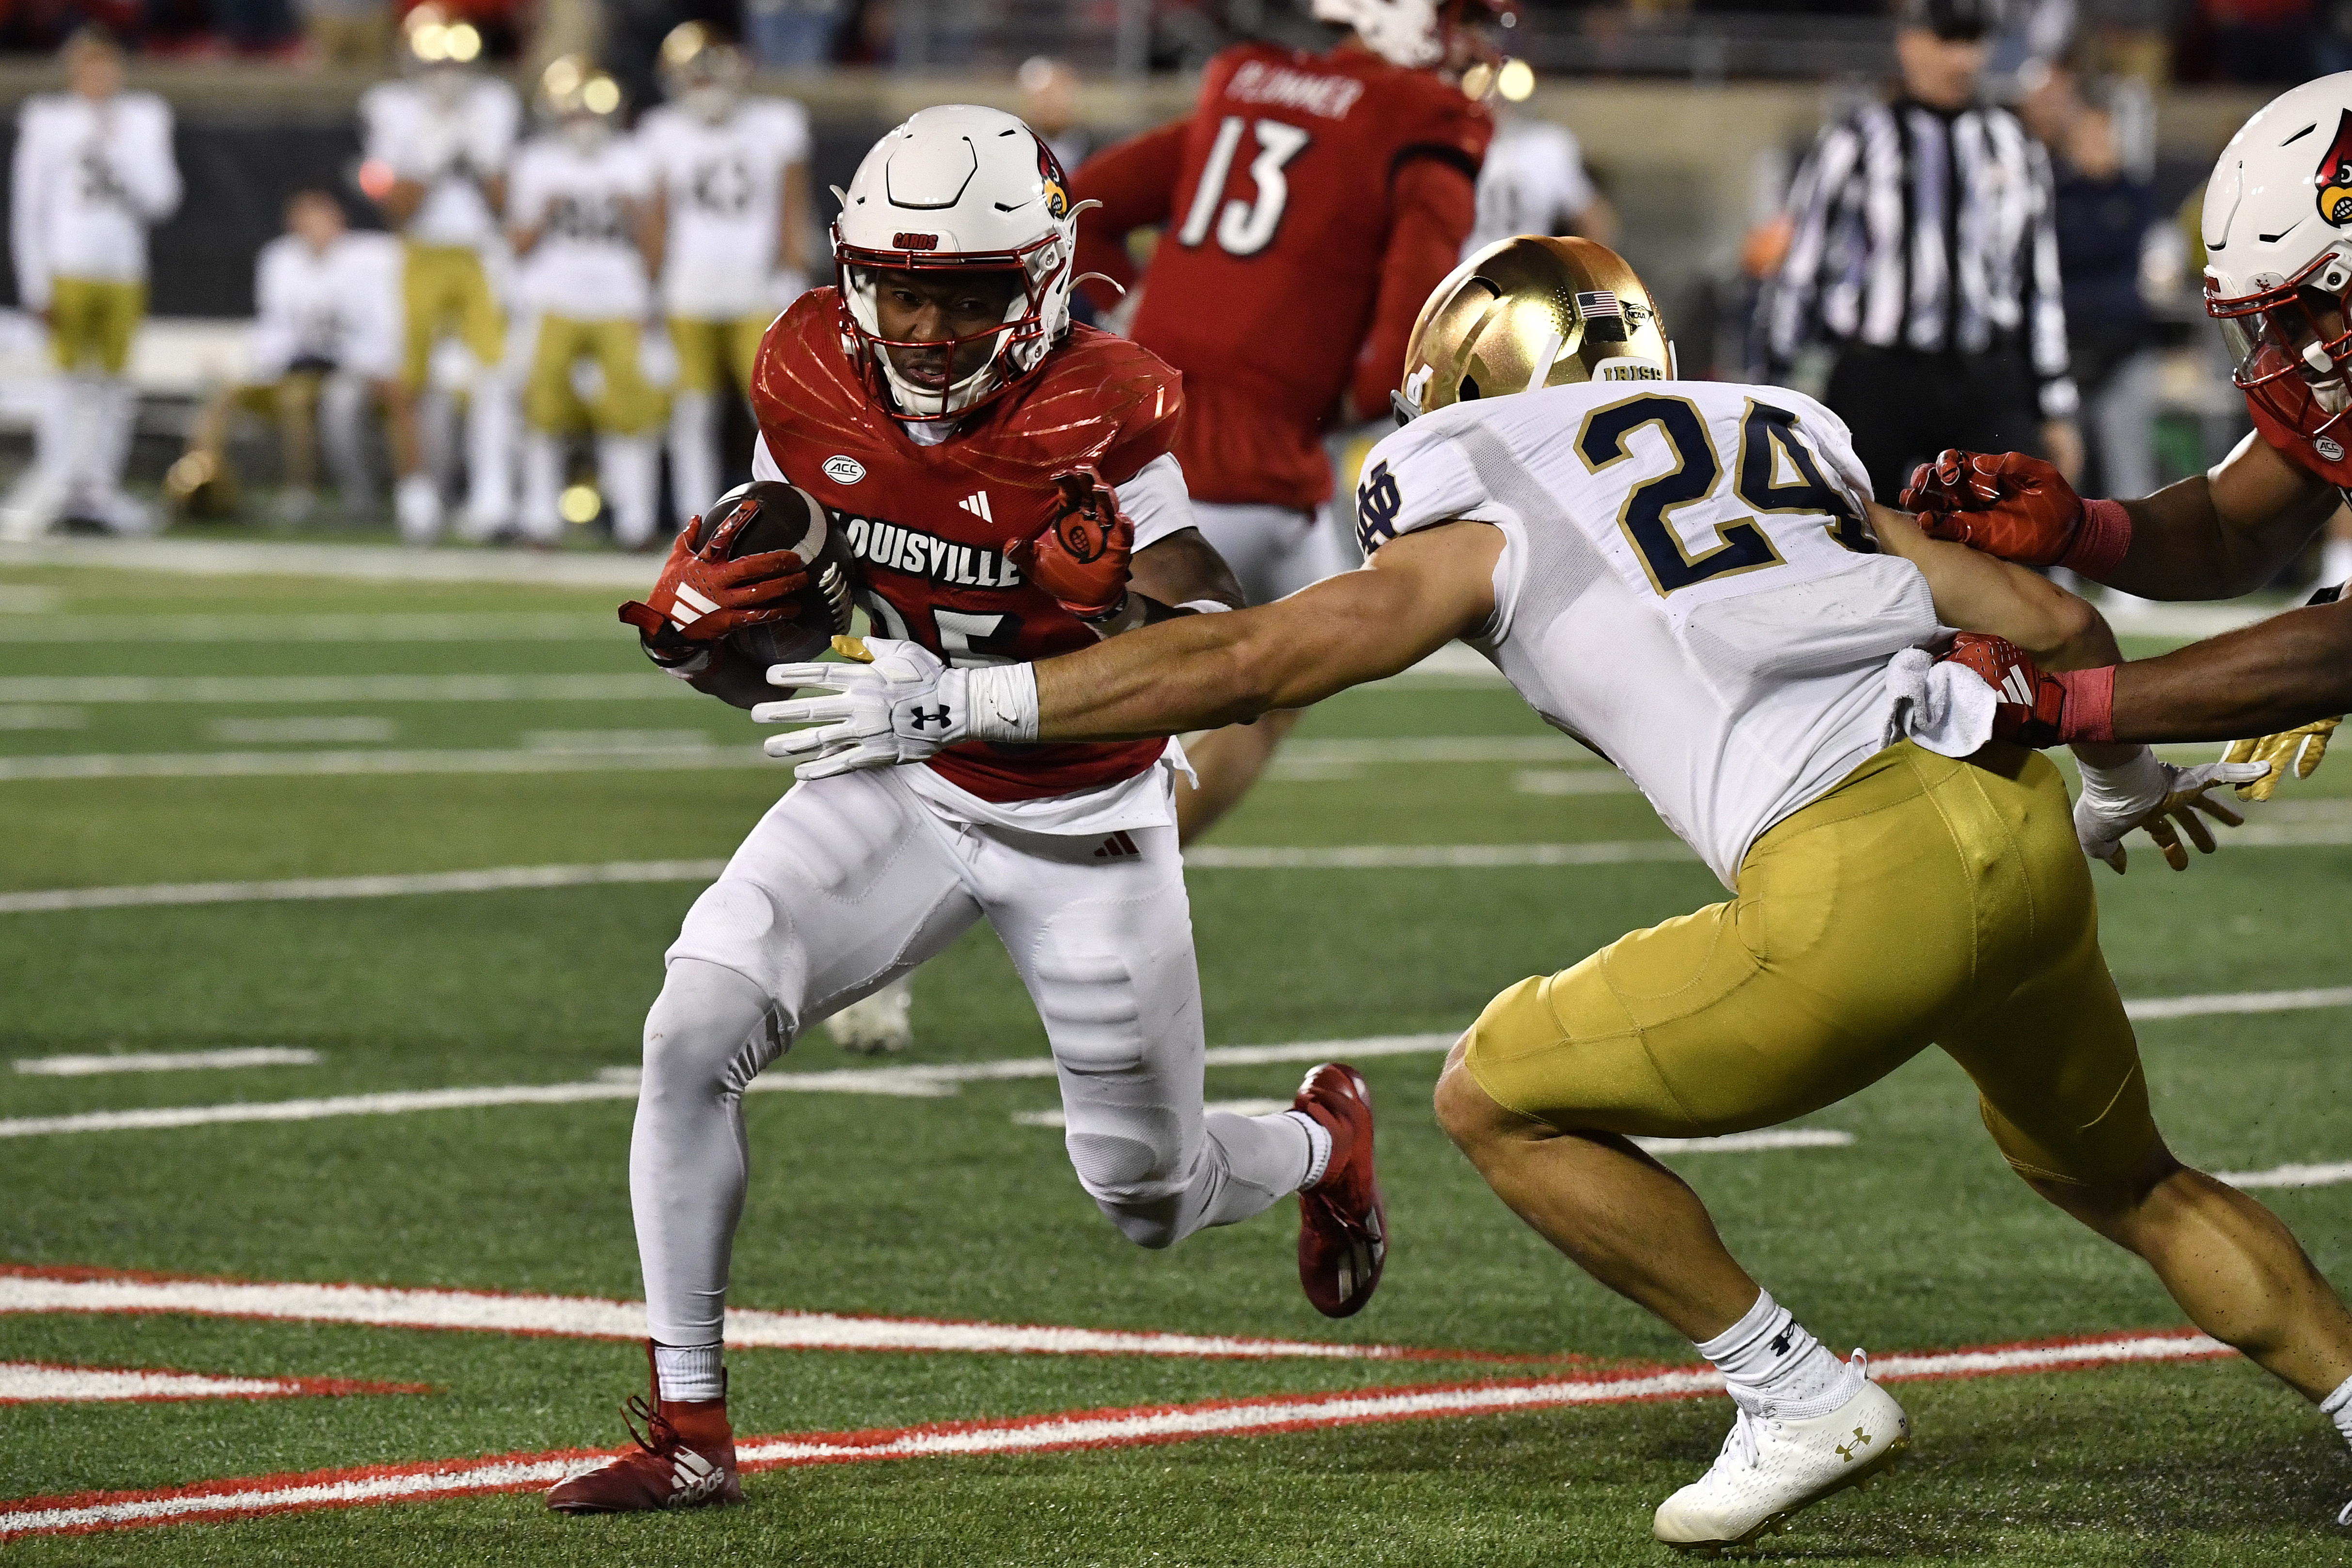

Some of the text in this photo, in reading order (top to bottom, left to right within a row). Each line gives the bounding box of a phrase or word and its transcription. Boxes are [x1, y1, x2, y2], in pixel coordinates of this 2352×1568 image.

[1179, 115, 1310, 257] 13
[893, 233, 939, 251] CARDS
[1627, 311, 1646, 319] NCAA
[1603, 365, 1663, 381] IRISH
[2320, 441, 2339, 451] ACC
[830, 463, 858, 474] ACC
[1573, 392, 1878, 599] 24
[831, 511, 1020, 587] OUISVILLE
[667, 1466, 724, 1505] adidas
